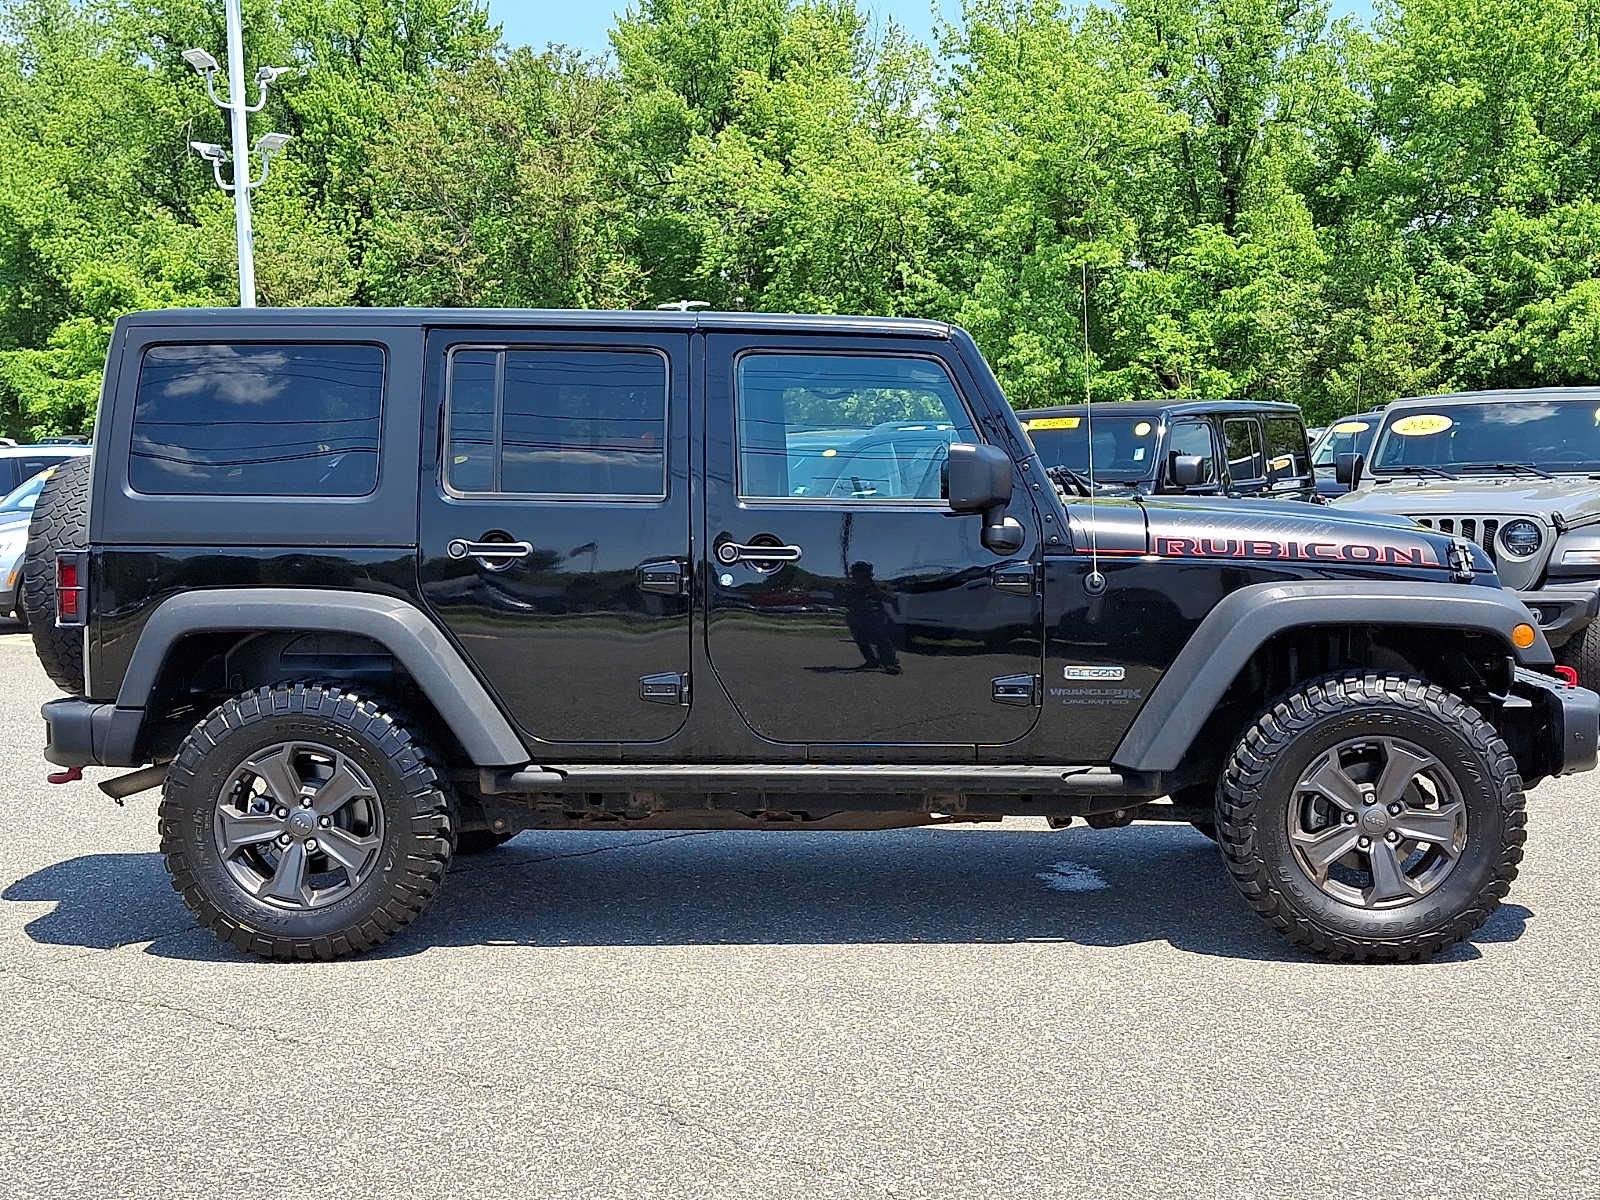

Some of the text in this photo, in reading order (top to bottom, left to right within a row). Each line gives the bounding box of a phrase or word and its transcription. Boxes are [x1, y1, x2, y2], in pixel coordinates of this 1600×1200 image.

[1152, 536, 1440, 567] RUBICON
[1066, 668, 1121, 678] RECON
[1050, 688, 1120, 696] WRANGLER
